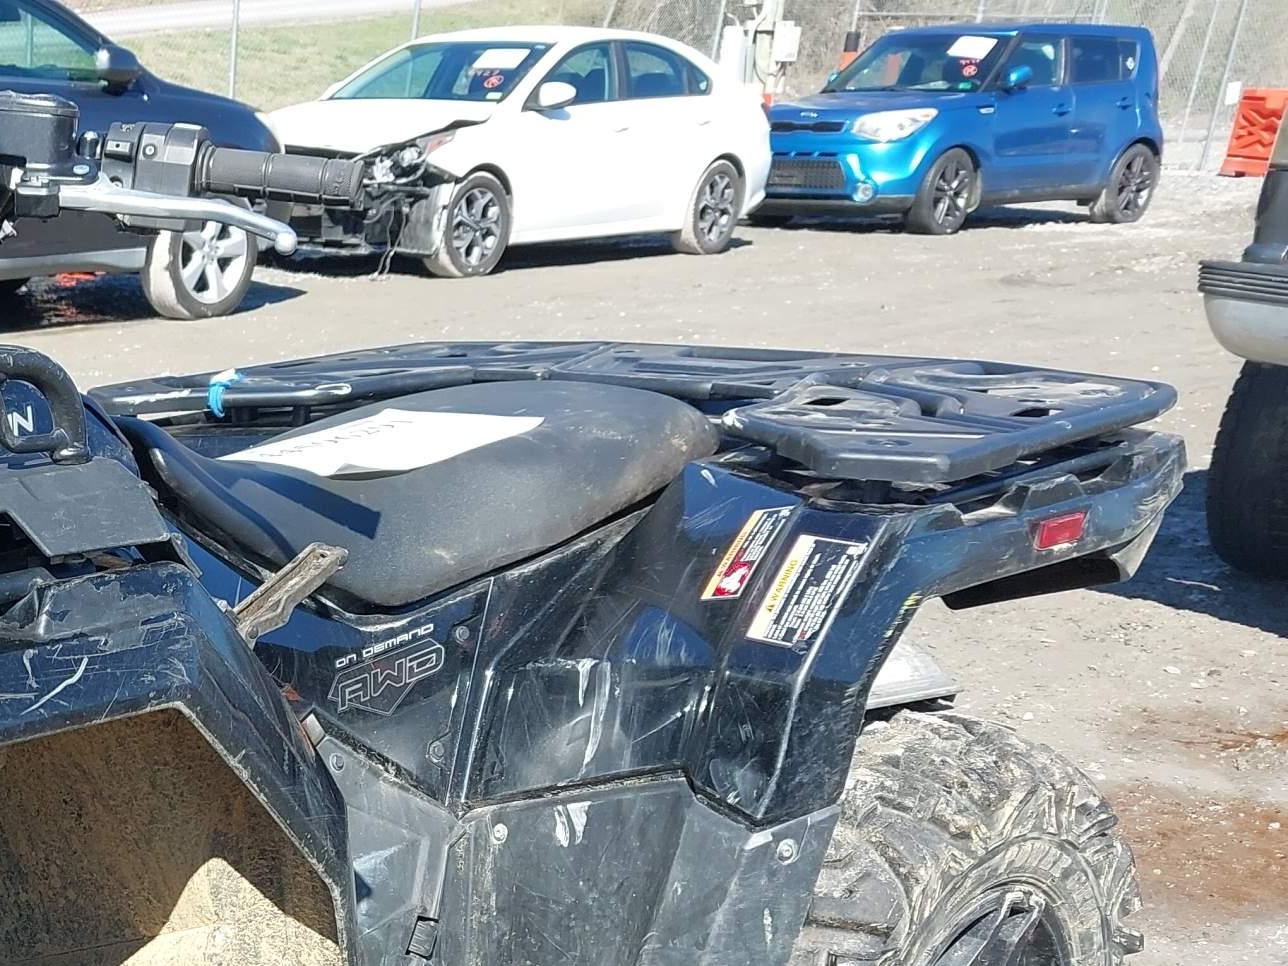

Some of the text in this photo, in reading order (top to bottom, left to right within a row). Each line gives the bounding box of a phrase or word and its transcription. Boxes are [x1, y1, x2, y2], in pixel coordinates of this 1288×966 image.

[770, 558, 800, 603] WARNING
[335, 623, 434, 669] ON DEMAND
[338, 644, 445, 713] AWD
